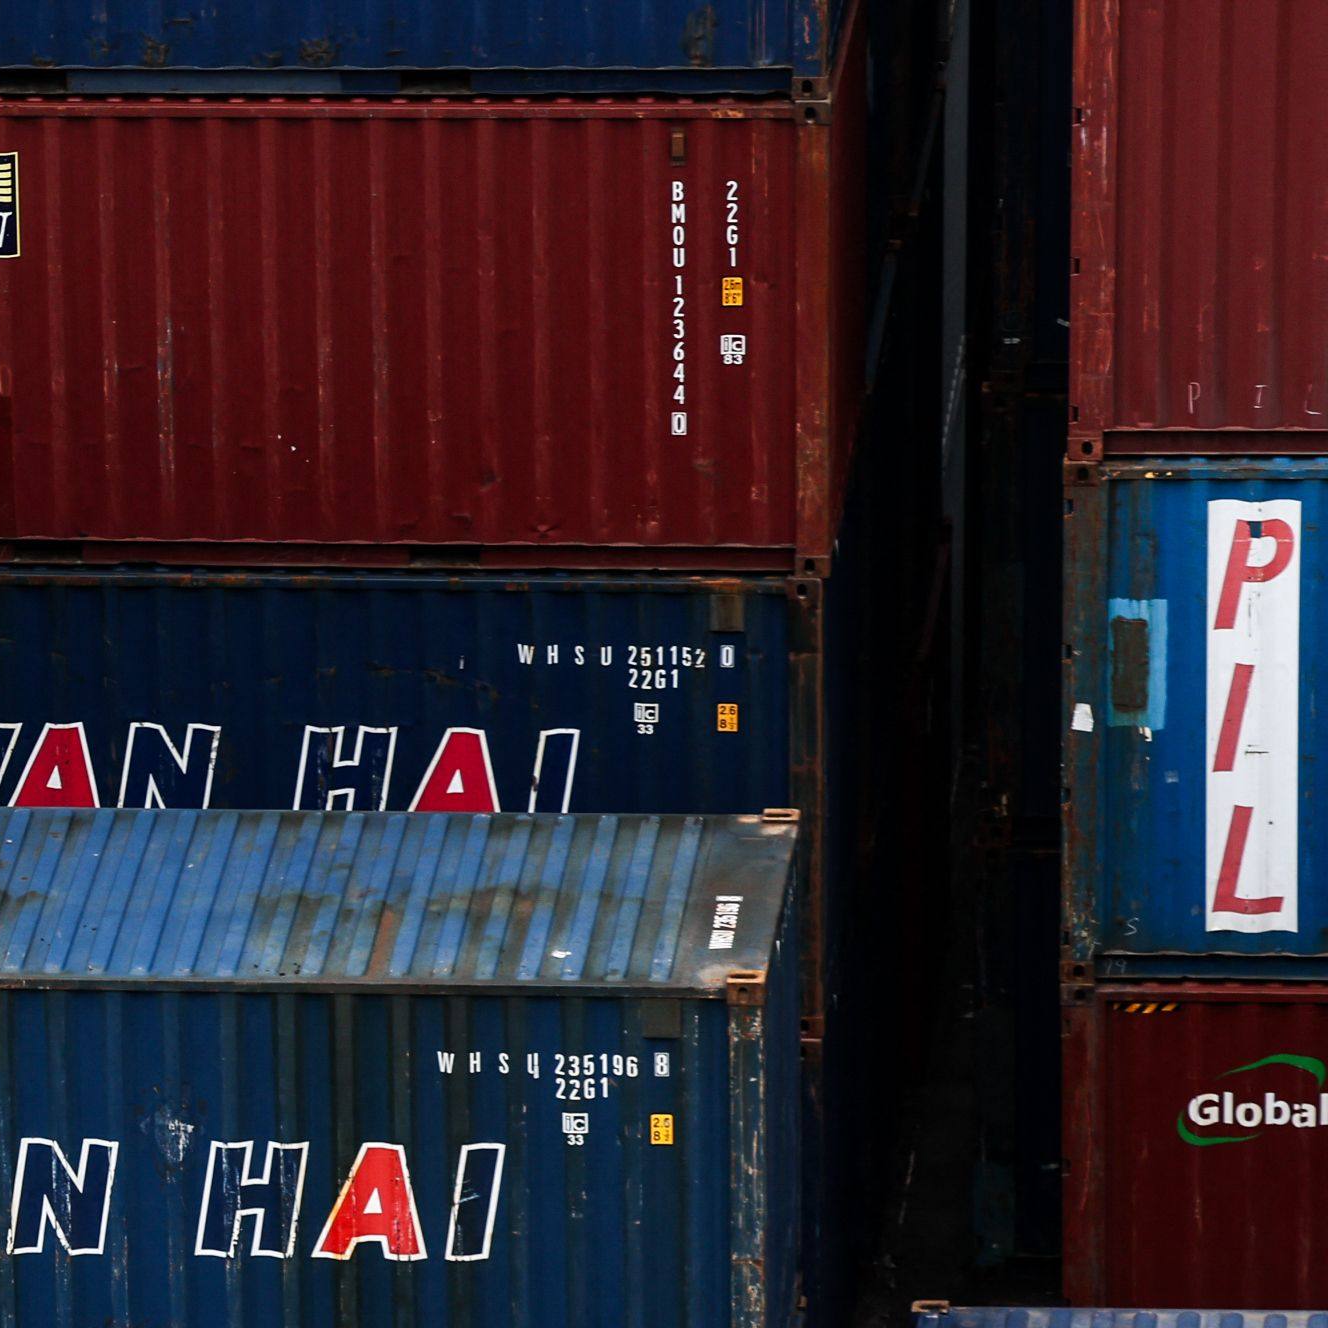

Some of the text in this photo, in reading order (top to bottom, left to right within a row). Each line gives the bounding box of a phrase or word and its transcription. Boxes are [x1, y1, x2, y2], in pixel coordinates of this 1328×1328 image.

[671, 181, 685, 268] BMOU
[726, 180, 738, 267] 22G1
[672, 275, 685, 404] 123644
[723, 354, 742, 365] 83
[627, 645, 706, 668] 251152
[628, 668, 679, 690] 22G1
[637, 724, 654, 735] 33
[1213, 518, 1294, 914] PIL
[293, 725, 581, 815] HAI
[554, 1053, 639, 1077] 235196
[555, 1077, 609, 1100] 22G1
[1188, 1092, 1328, 1128] Global
[567, 1135, 584, 1146] 33
[195, 1139, 506, 1262] HAI
